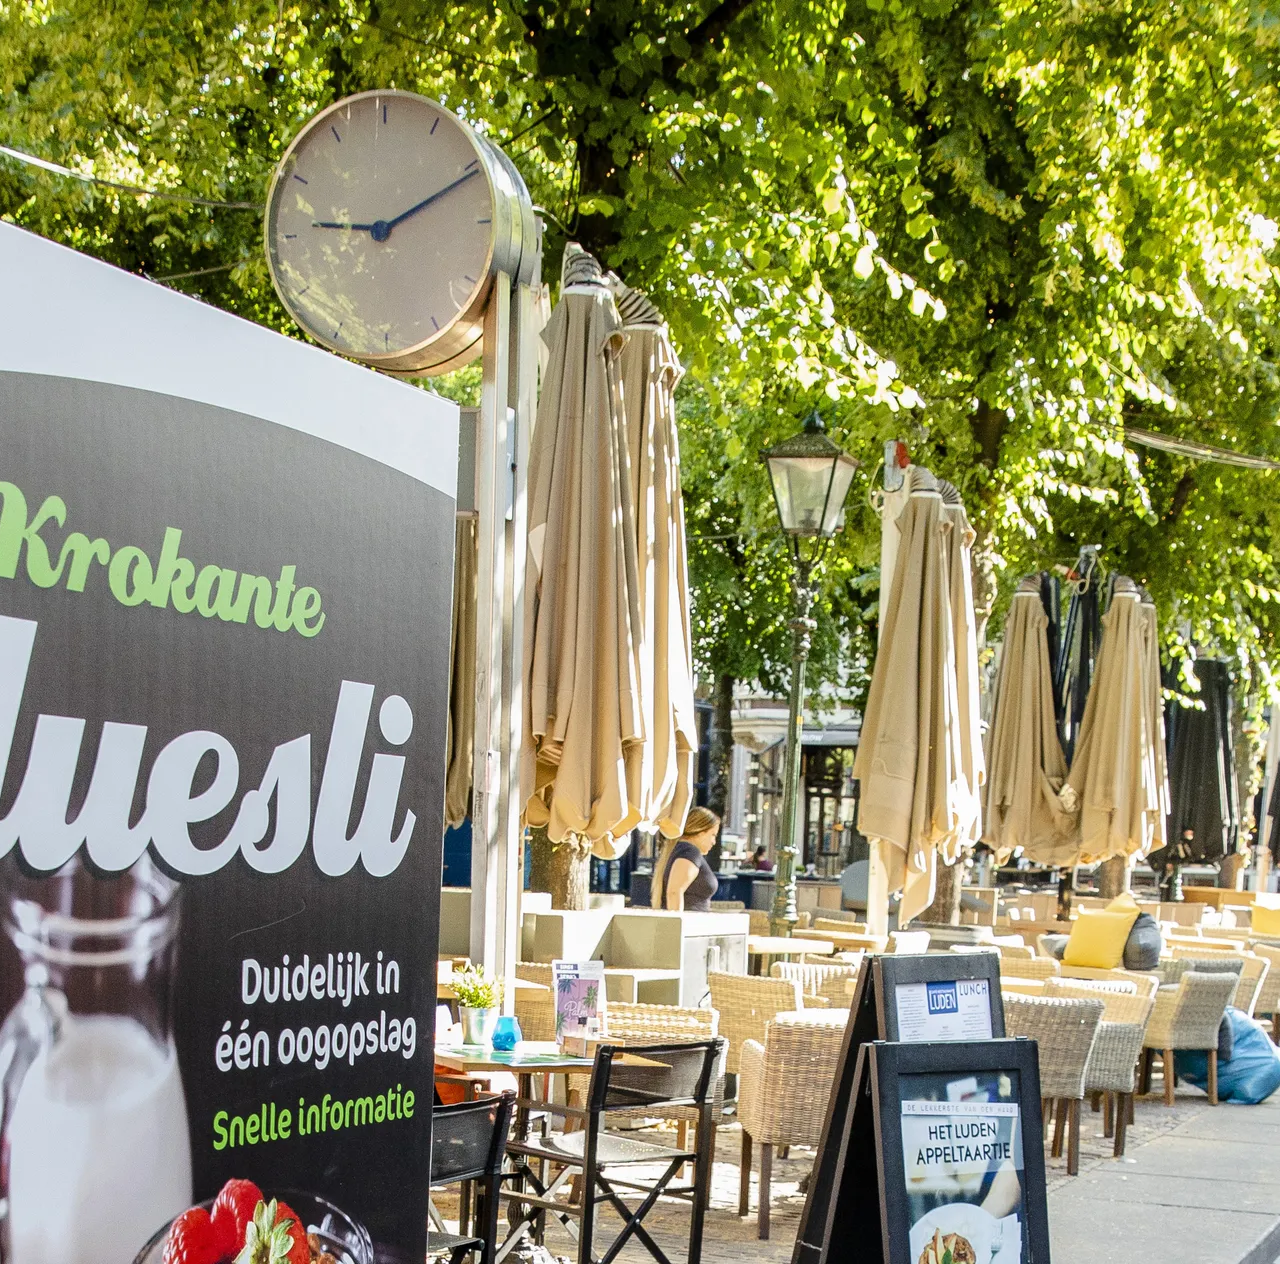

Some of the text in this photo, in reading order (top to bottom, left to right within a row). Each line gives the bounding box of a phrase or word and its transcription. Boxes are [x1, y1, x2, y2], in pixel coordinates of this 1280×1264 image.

[242, 951, 399, 1005] Duidelijk in
[929, 989, 956, 1010] LUDEN
[959, 983, 987, 996] LUNCH
[564, 1001, 588, 1017] Palm
[216, 1014, 417, 1072] één oogopslag
[212, 1083, 415, 1151] Snelle informatie
[929, 1122, 996, 1140] HET LUDEN
[917, 1143, 1011, 1165] APPELTAARTJE
